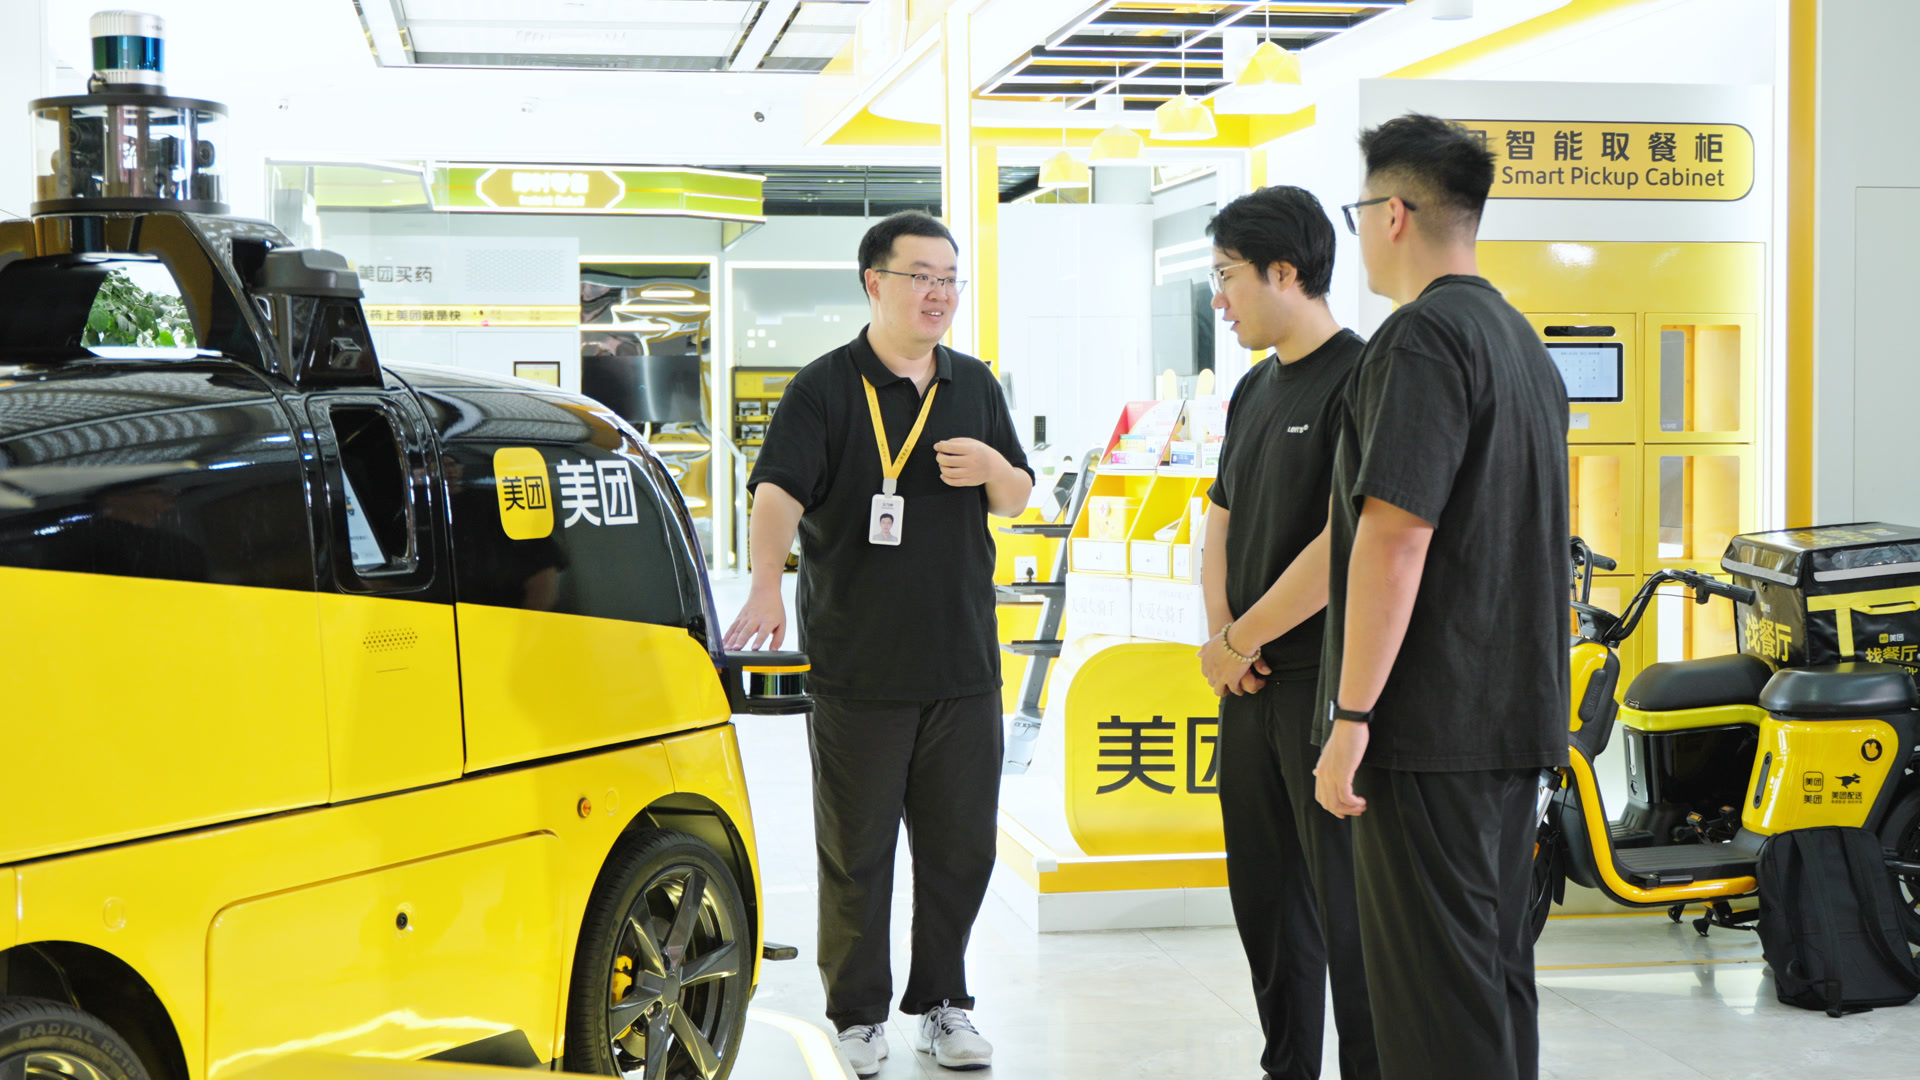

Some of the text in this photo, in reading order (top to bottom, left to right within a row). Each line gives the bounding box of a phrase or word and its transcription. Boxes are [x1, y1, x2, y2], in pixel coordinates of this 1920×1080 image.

[1470, 130, 1724, 163] 智能取餐柜
[1502, 166, 1564, 185] Smart
[1571, 167, 1639, 190] Pickup
[1645, 168, 1725, 187] Cabinet
[358, 265, 433, 283] 美团买药
[502, 475, 547, 511] 美团
[556, 459, 639, 528] 美团
[1745, 612, 1792, 662] 找餐厅
[1865, 645, 1918, 664] 找餐厅
[19, 1023, 95, 1043] RADIAL
